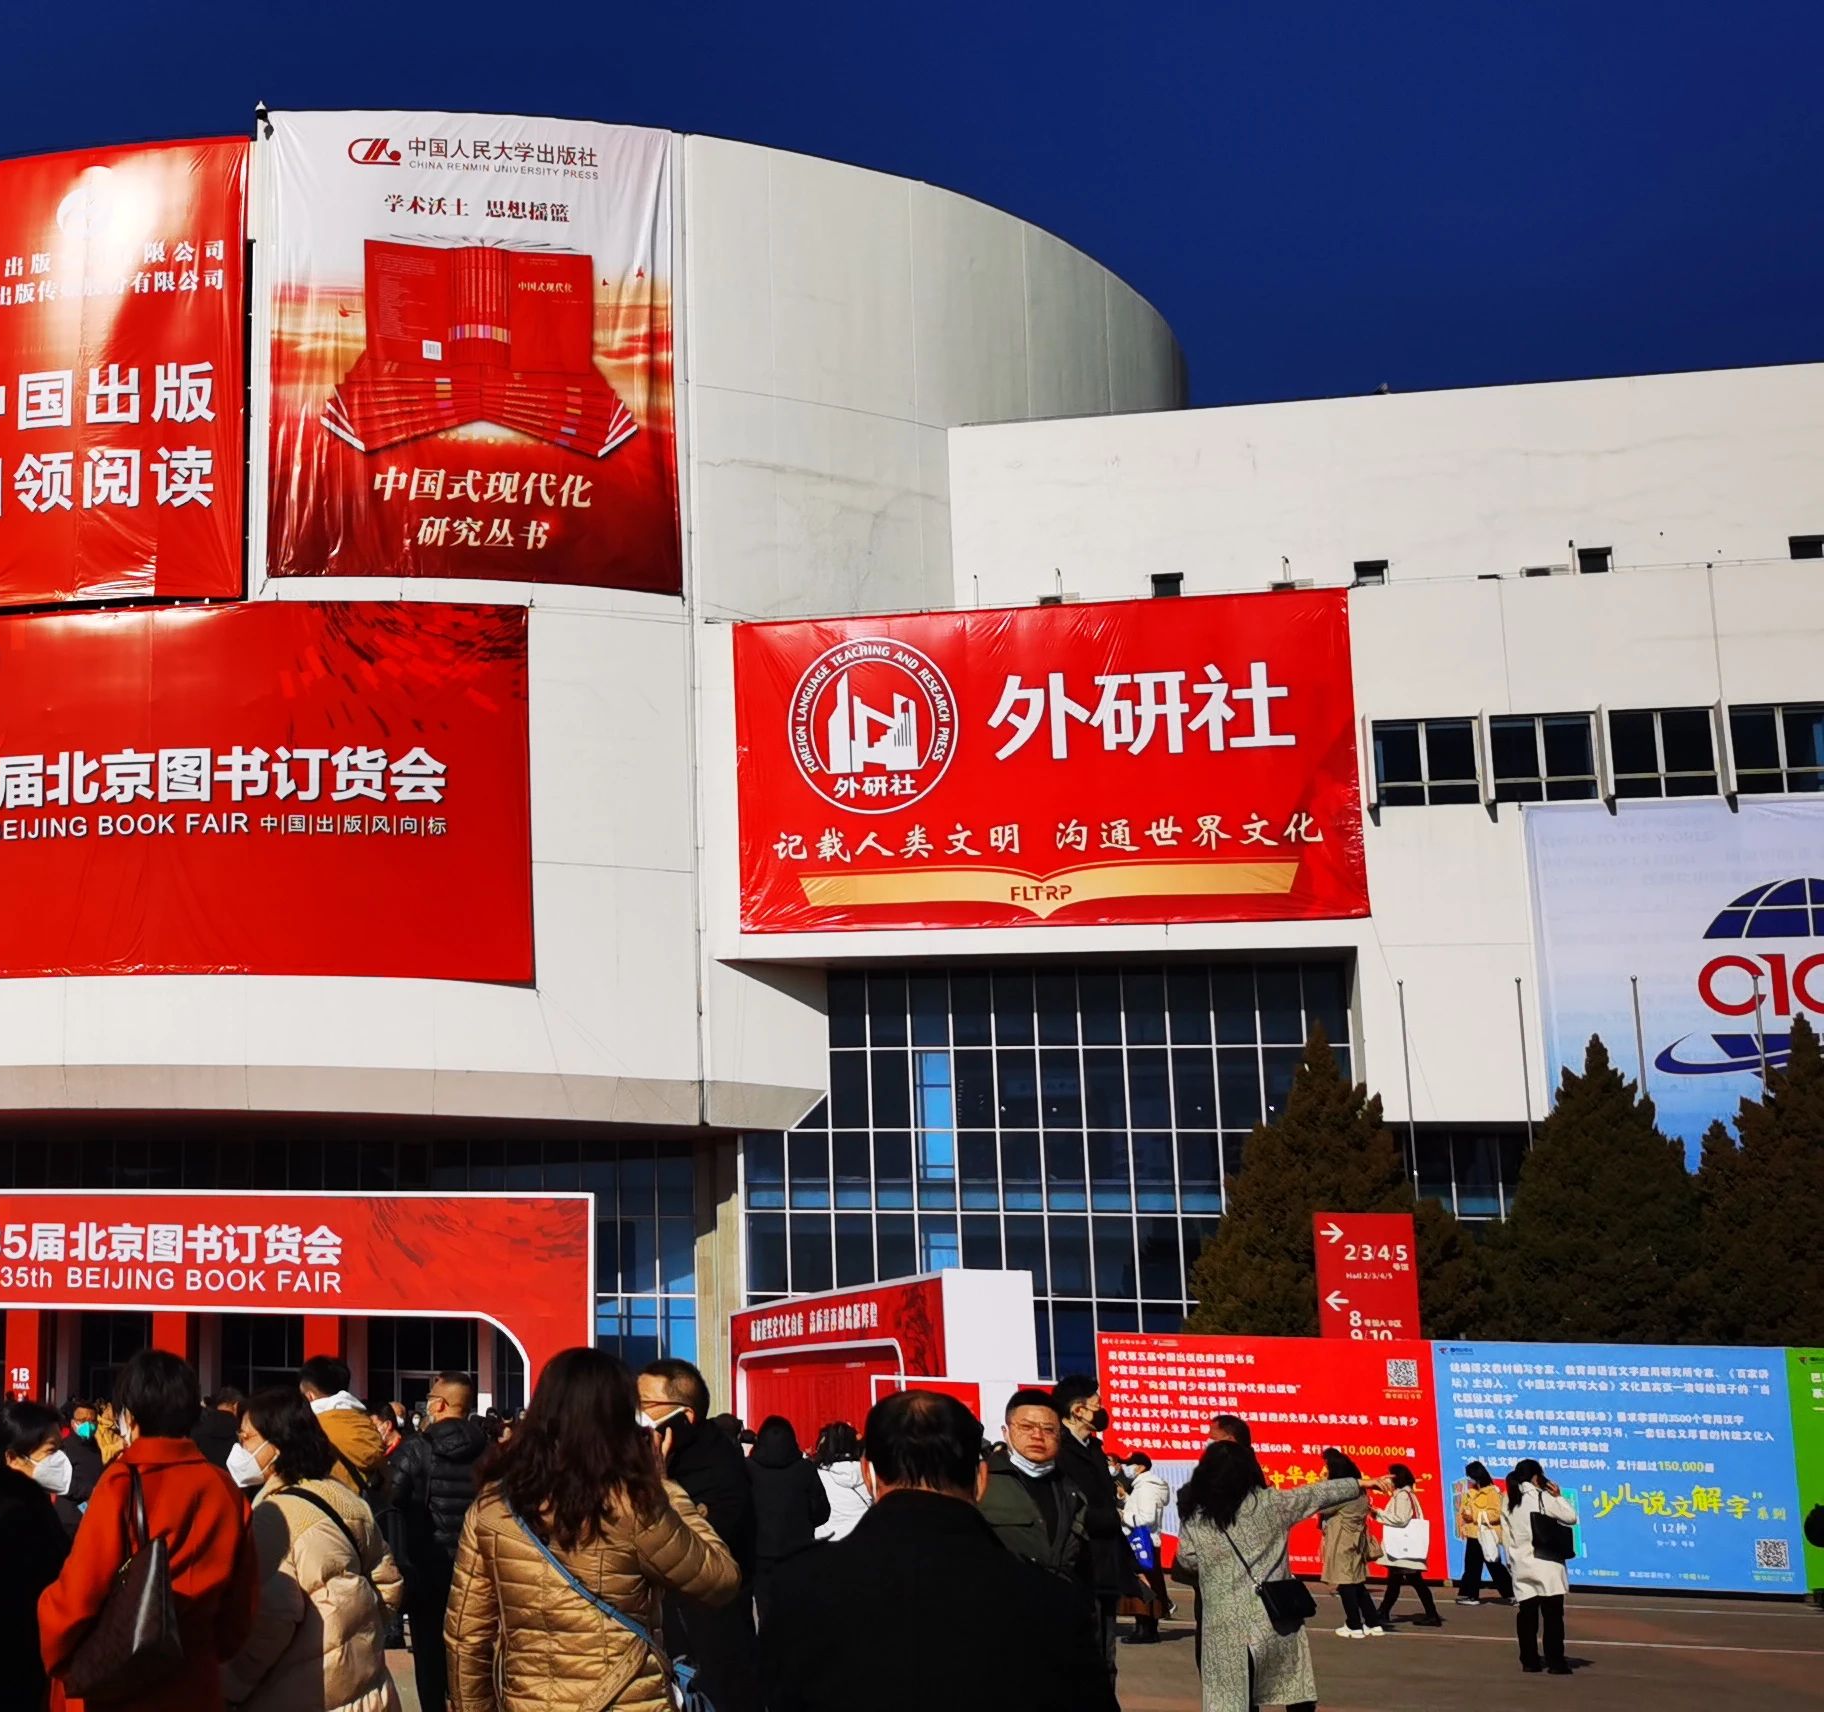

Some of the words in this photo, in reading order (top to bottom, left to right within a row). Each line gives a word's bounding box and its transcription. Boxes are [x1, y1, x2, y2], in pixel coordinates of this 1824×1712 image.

[408, 136, 599, 168] 中国人民大学出版社
[409, 160, 442, 171] CHINA
[446, 162, 490, 174] RENMIN
[493, 165, 559, 178] UNIVERSITY
[563, 169, 599, 180] PRESS
[384, 194, 469, 218] 学术沃土
[485, 199, 571, 223] 思想摇篮
[373, 466, 594, 508] 中国式现代化
[417, 516, 550, 550] 研究丛书
[831, 645, 890, 667] TEACHING
[893, 651, 919, 669] AND
[796, 664, 831, 721] LANGUAGE
[918, 668, 950, 722] RESEARCH
[988, 661, 1296, 761] 外研社
[796, 726, 819, 773] FOREIGN
[932, 727, 950, 762] PRESS
[833, 774, 918, 798] 外研社
[97, 813, 175, 838] BOOK
[185, 811, 249, 835] FAIR
[773, 823, 1019, 862] 记载人类文明
[1055, 812, 1324, 851] 沟通世界文化
[1010, 884, 1072, 902] FLTRP
[1344, 1244, 1408, 1261] 2/3/4/5
[0, 1267, 52, 1289] 35th
[66, 1267, 175, 1291] BEIJING
[185, 1268, 266, 1292] BOOK
[276, 1270, 343, 1294] FAIR
[1349, 1310, 1362, 1327] 8
[10, 1367, 30, 1382] 1B
